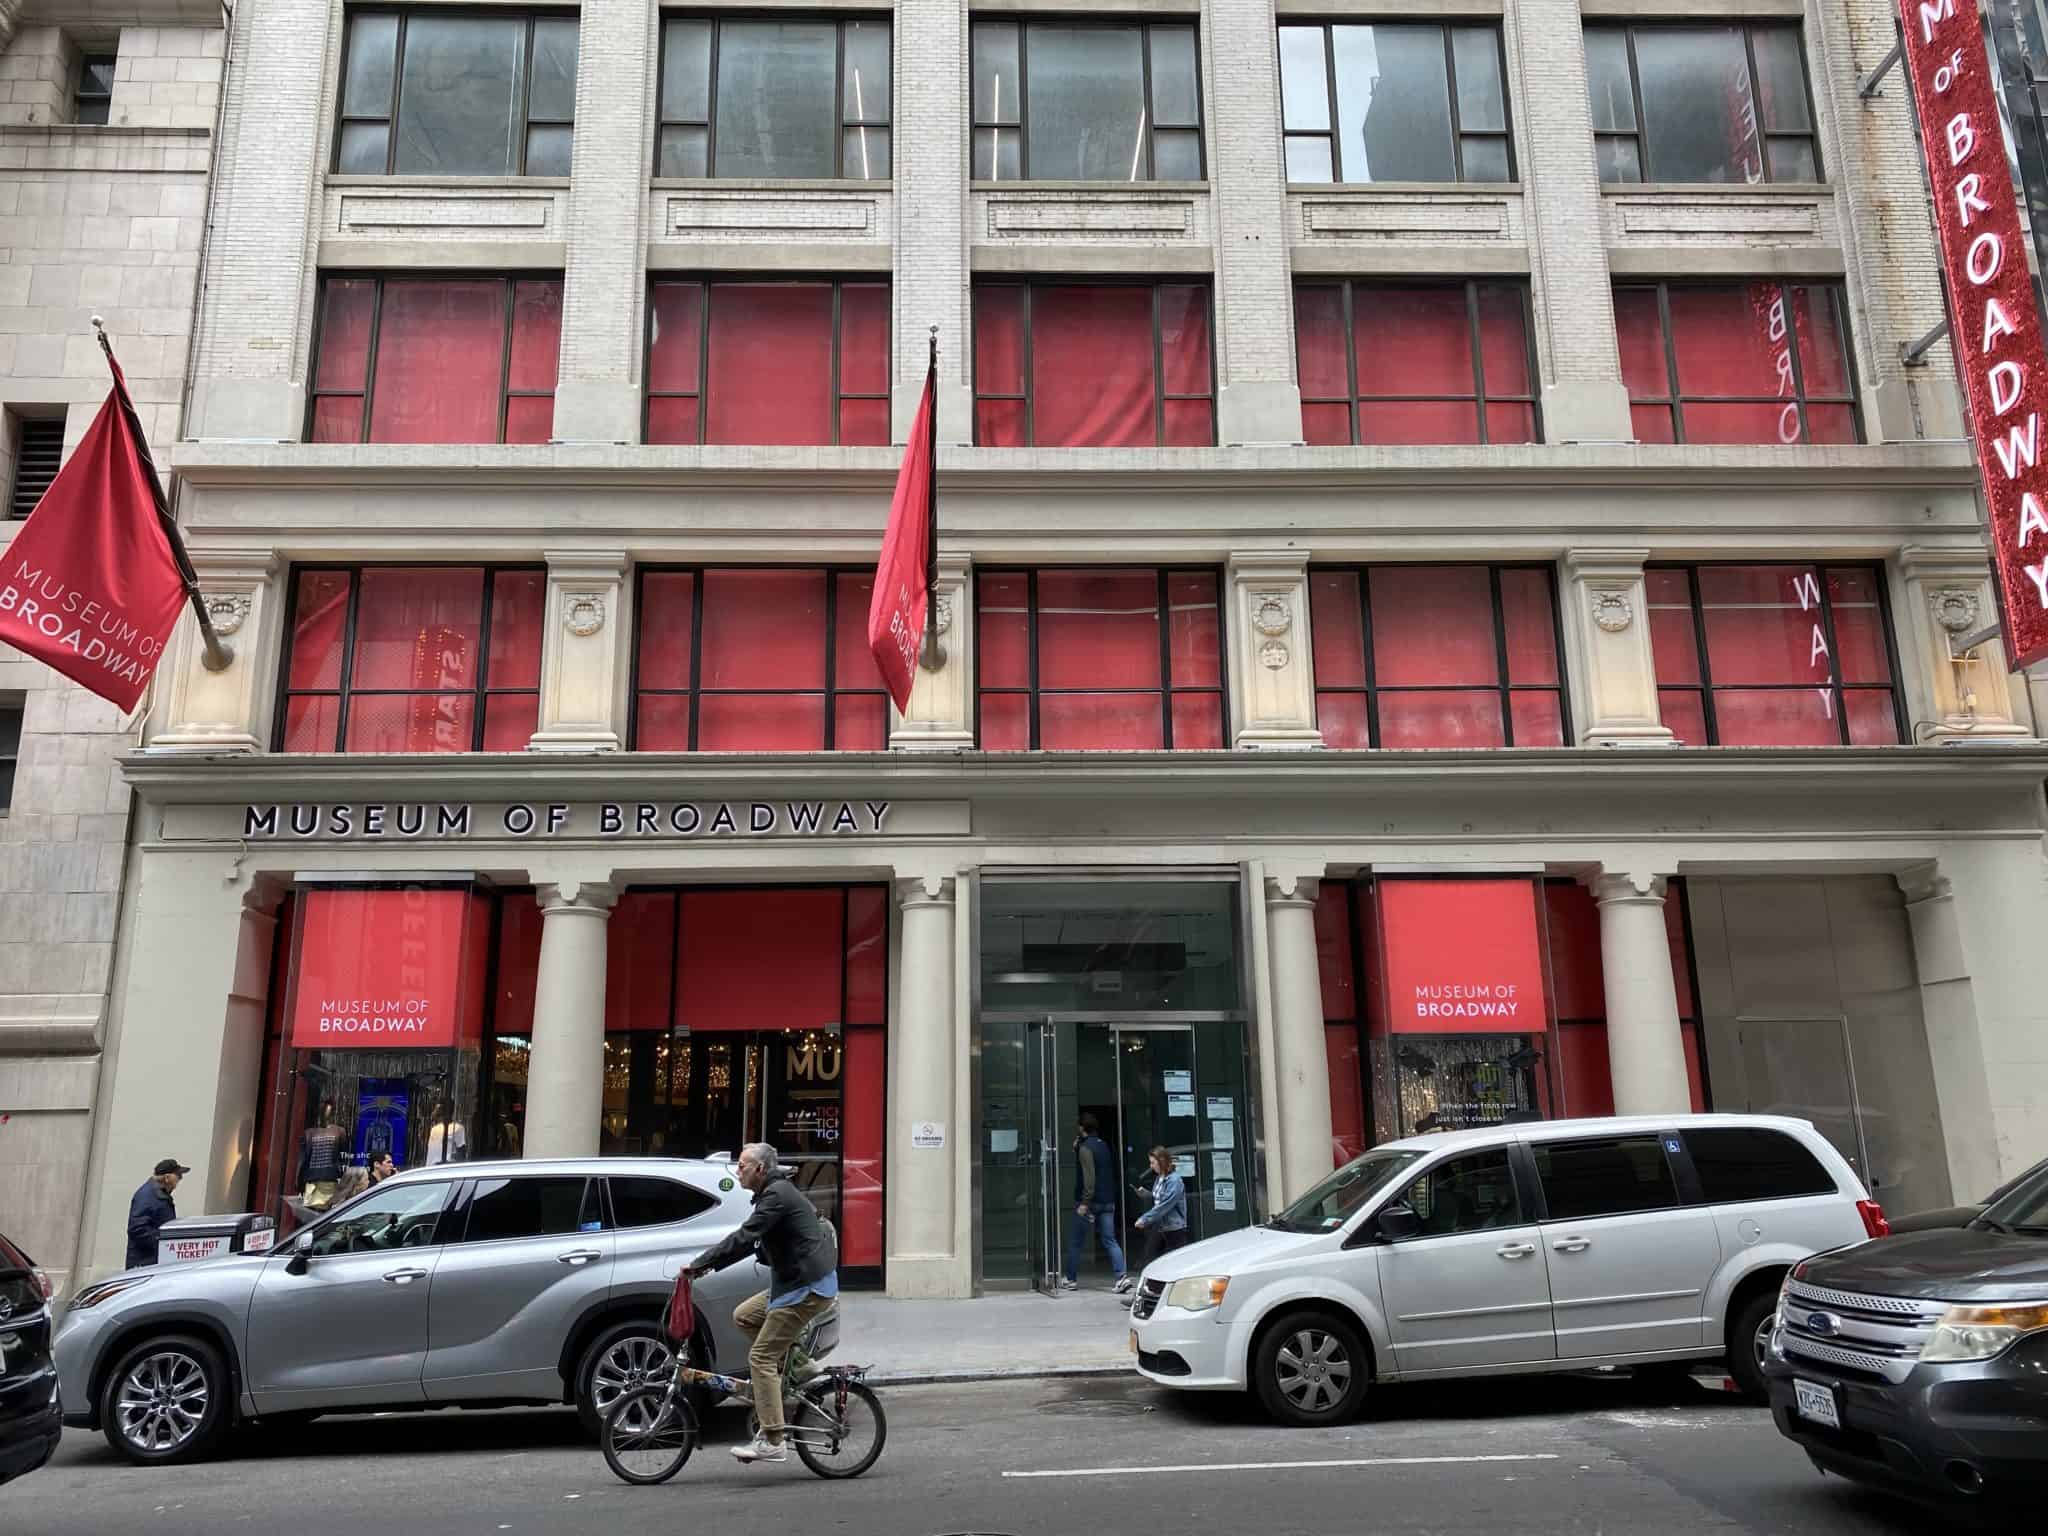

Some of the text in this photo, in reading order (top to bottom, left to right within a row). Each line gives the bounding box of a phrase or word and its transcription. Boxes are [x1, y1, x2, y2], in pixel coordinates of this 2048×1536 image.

[1934, 47, 1963, 93] OF
[14, 560, 163, 658] MUSEUM OF
[0, 585, 150, 686] BROADWAY
[244, 801, 888, 835] MUSEUM OF BROADWAY
[1416, 985, 1517, 999] MUSEUM OF
[321, 1000, 430, 1014] MUSEUM OF
[1417, 1002, 1518, 1017] BROADWAY
[319, 1017, 427, 1033] BROADWAY
[177, 1241, 200, 1251] VERY
[203, 1240, 220, 1250] HOT
